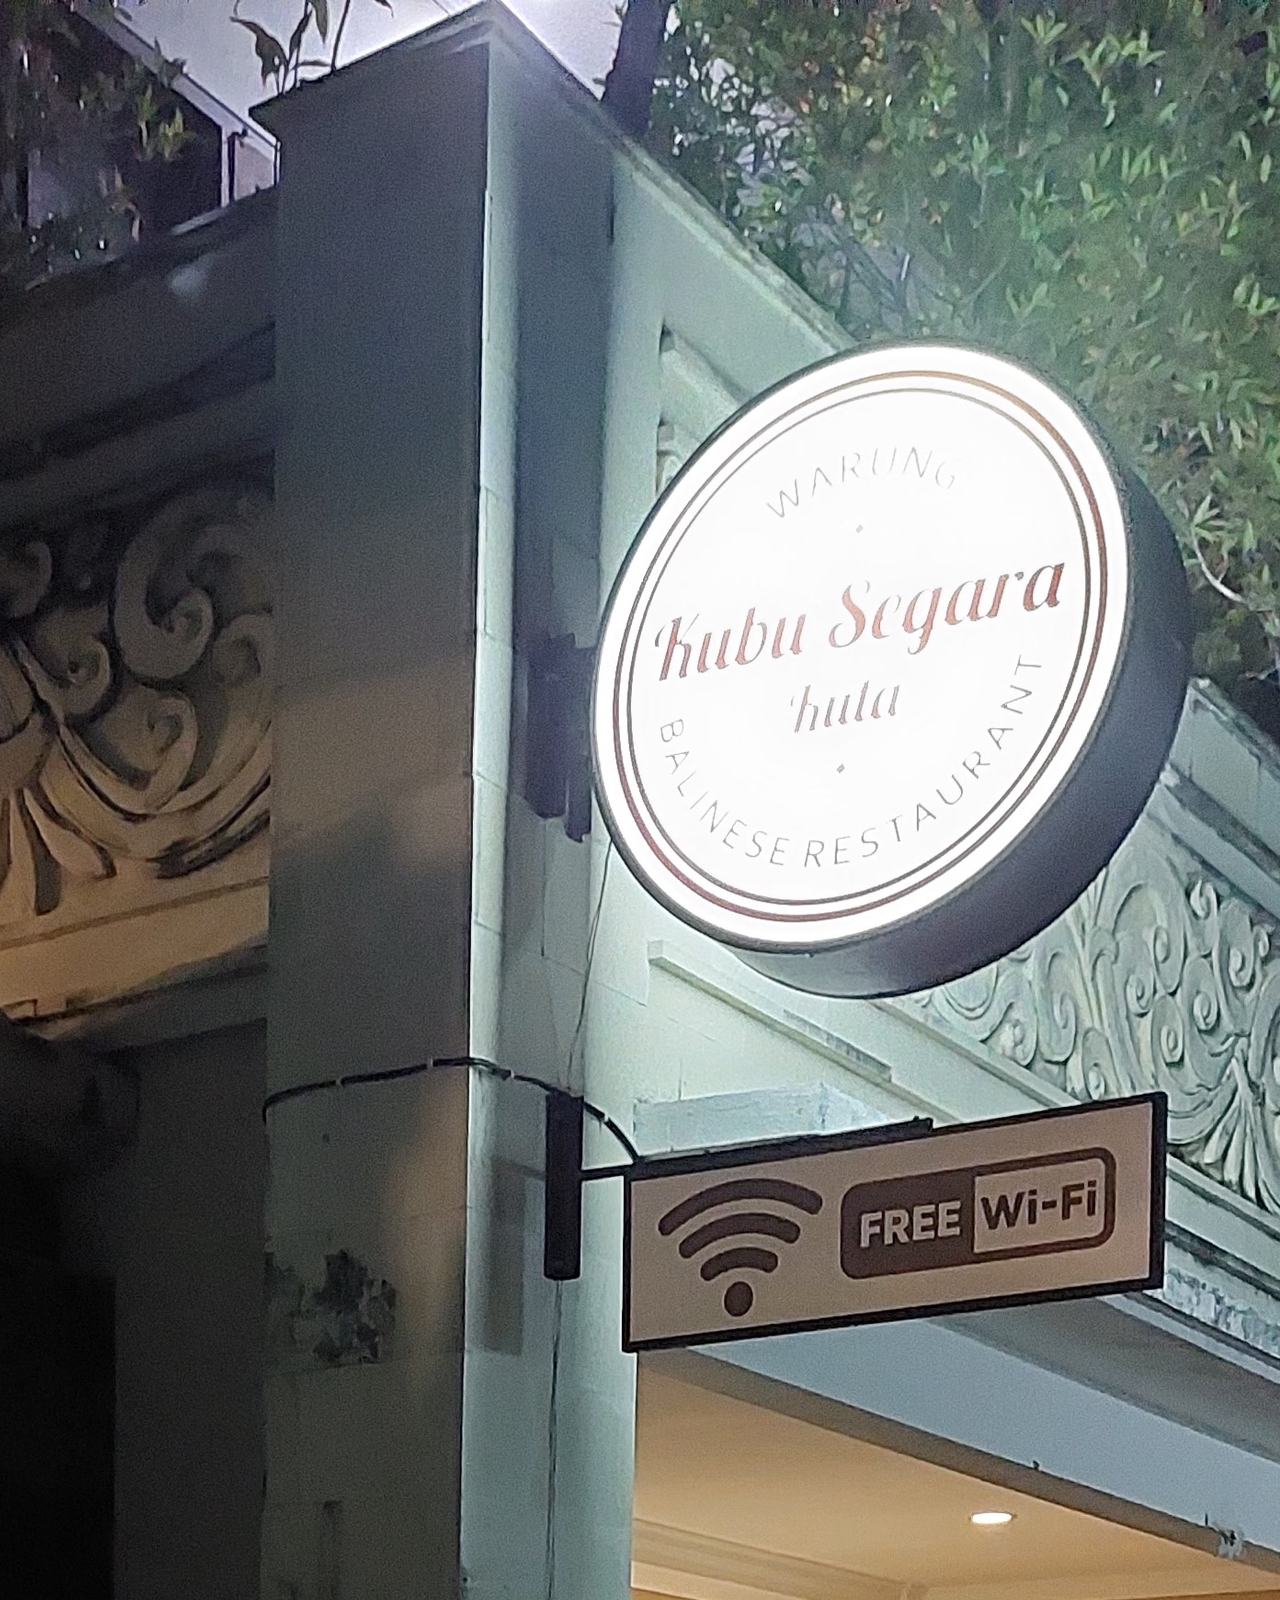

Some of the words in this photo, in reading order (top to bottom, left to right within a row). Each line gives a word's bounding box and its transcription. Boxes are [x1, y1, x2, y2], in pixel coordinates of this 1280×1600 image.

[765, 446, 957, 519] WARUNG
[654, 606, 807, 681] Kubu
[828, 562, 1065, 655] Segara
[659, 718, 790, 867] BALINESE
[803, 654, 1043, 868] RESTAURANT
[859, 1200, 961, 1248] FREE
[980, 1179, 1098, 1231] Wi-Fi
